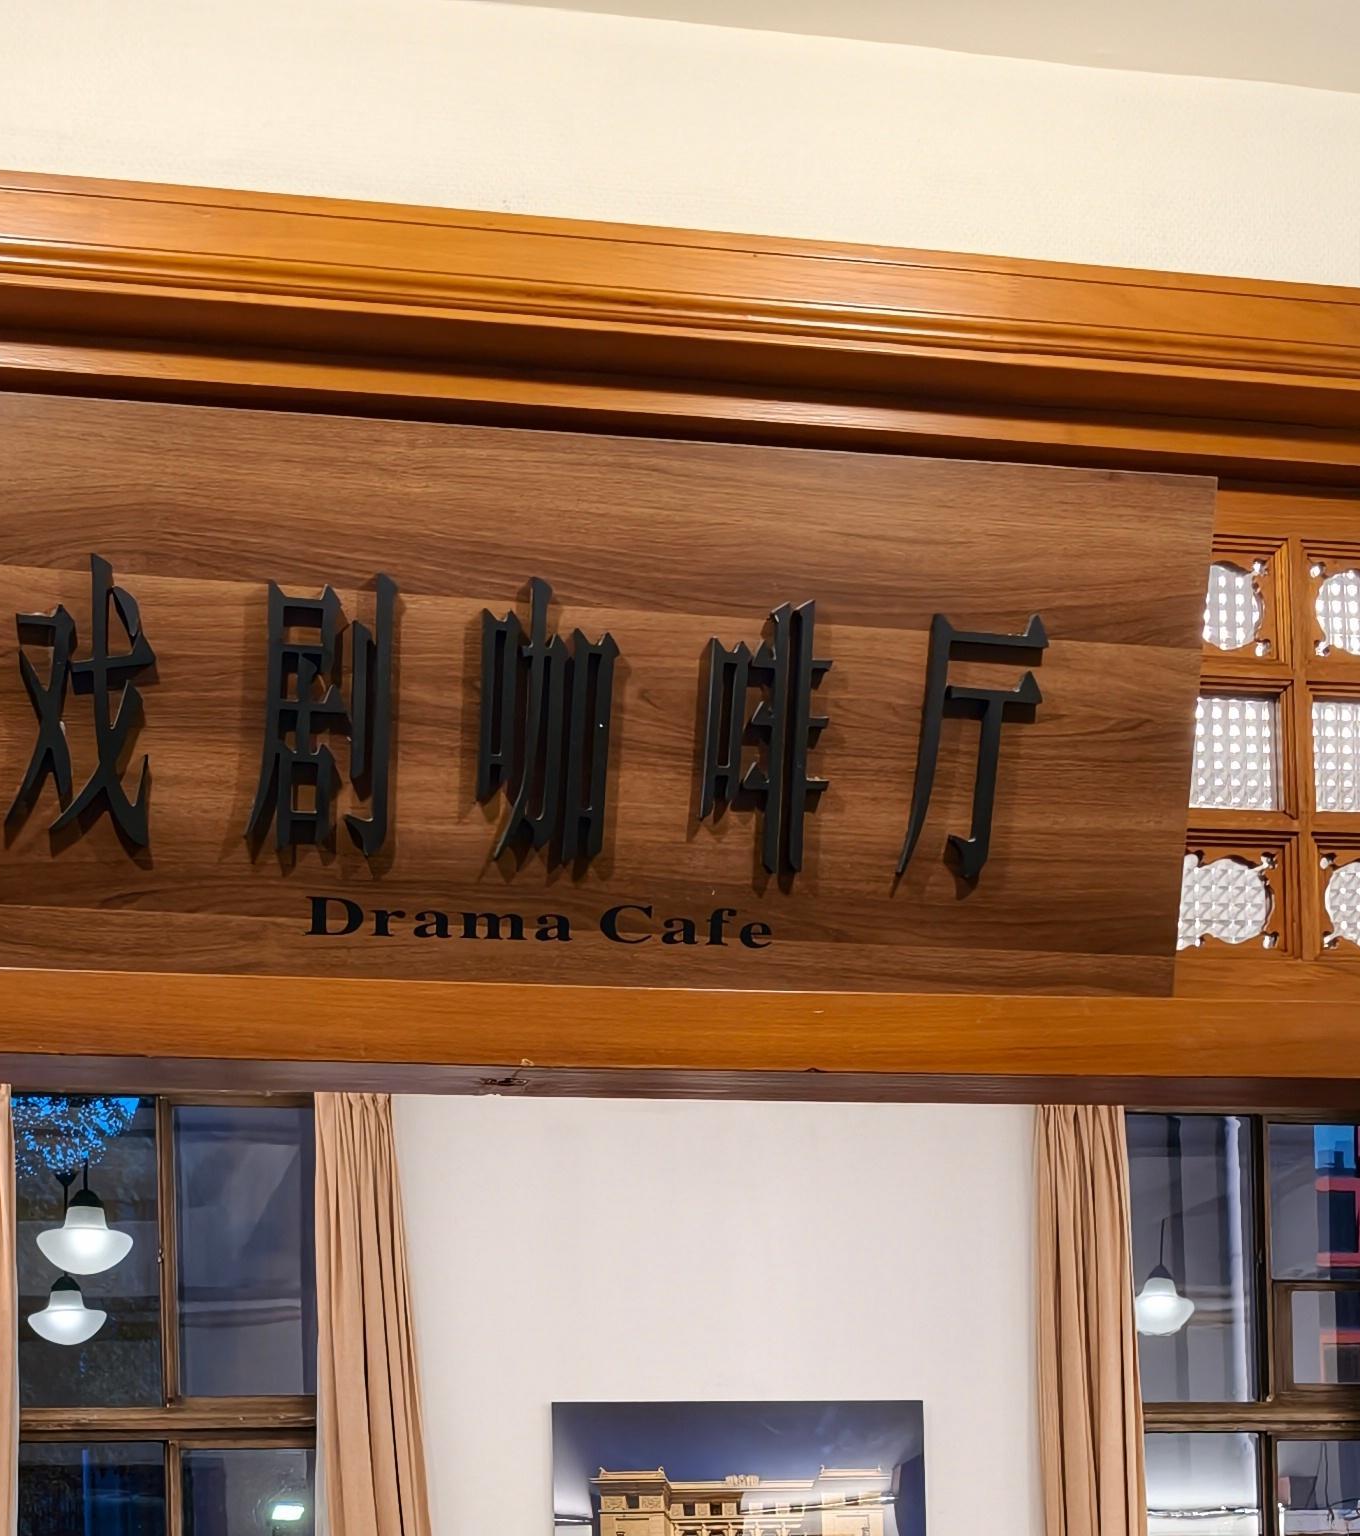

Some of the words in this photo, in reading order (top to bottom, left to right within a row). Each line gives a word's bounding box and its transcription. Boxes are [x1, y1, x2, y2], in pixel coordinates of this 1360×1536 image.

[3, 553, 1049, 881] 戏剧咖啡厅
[303, 895, 573, 942] Drama
[599, 903, 773, 949] Cafe
